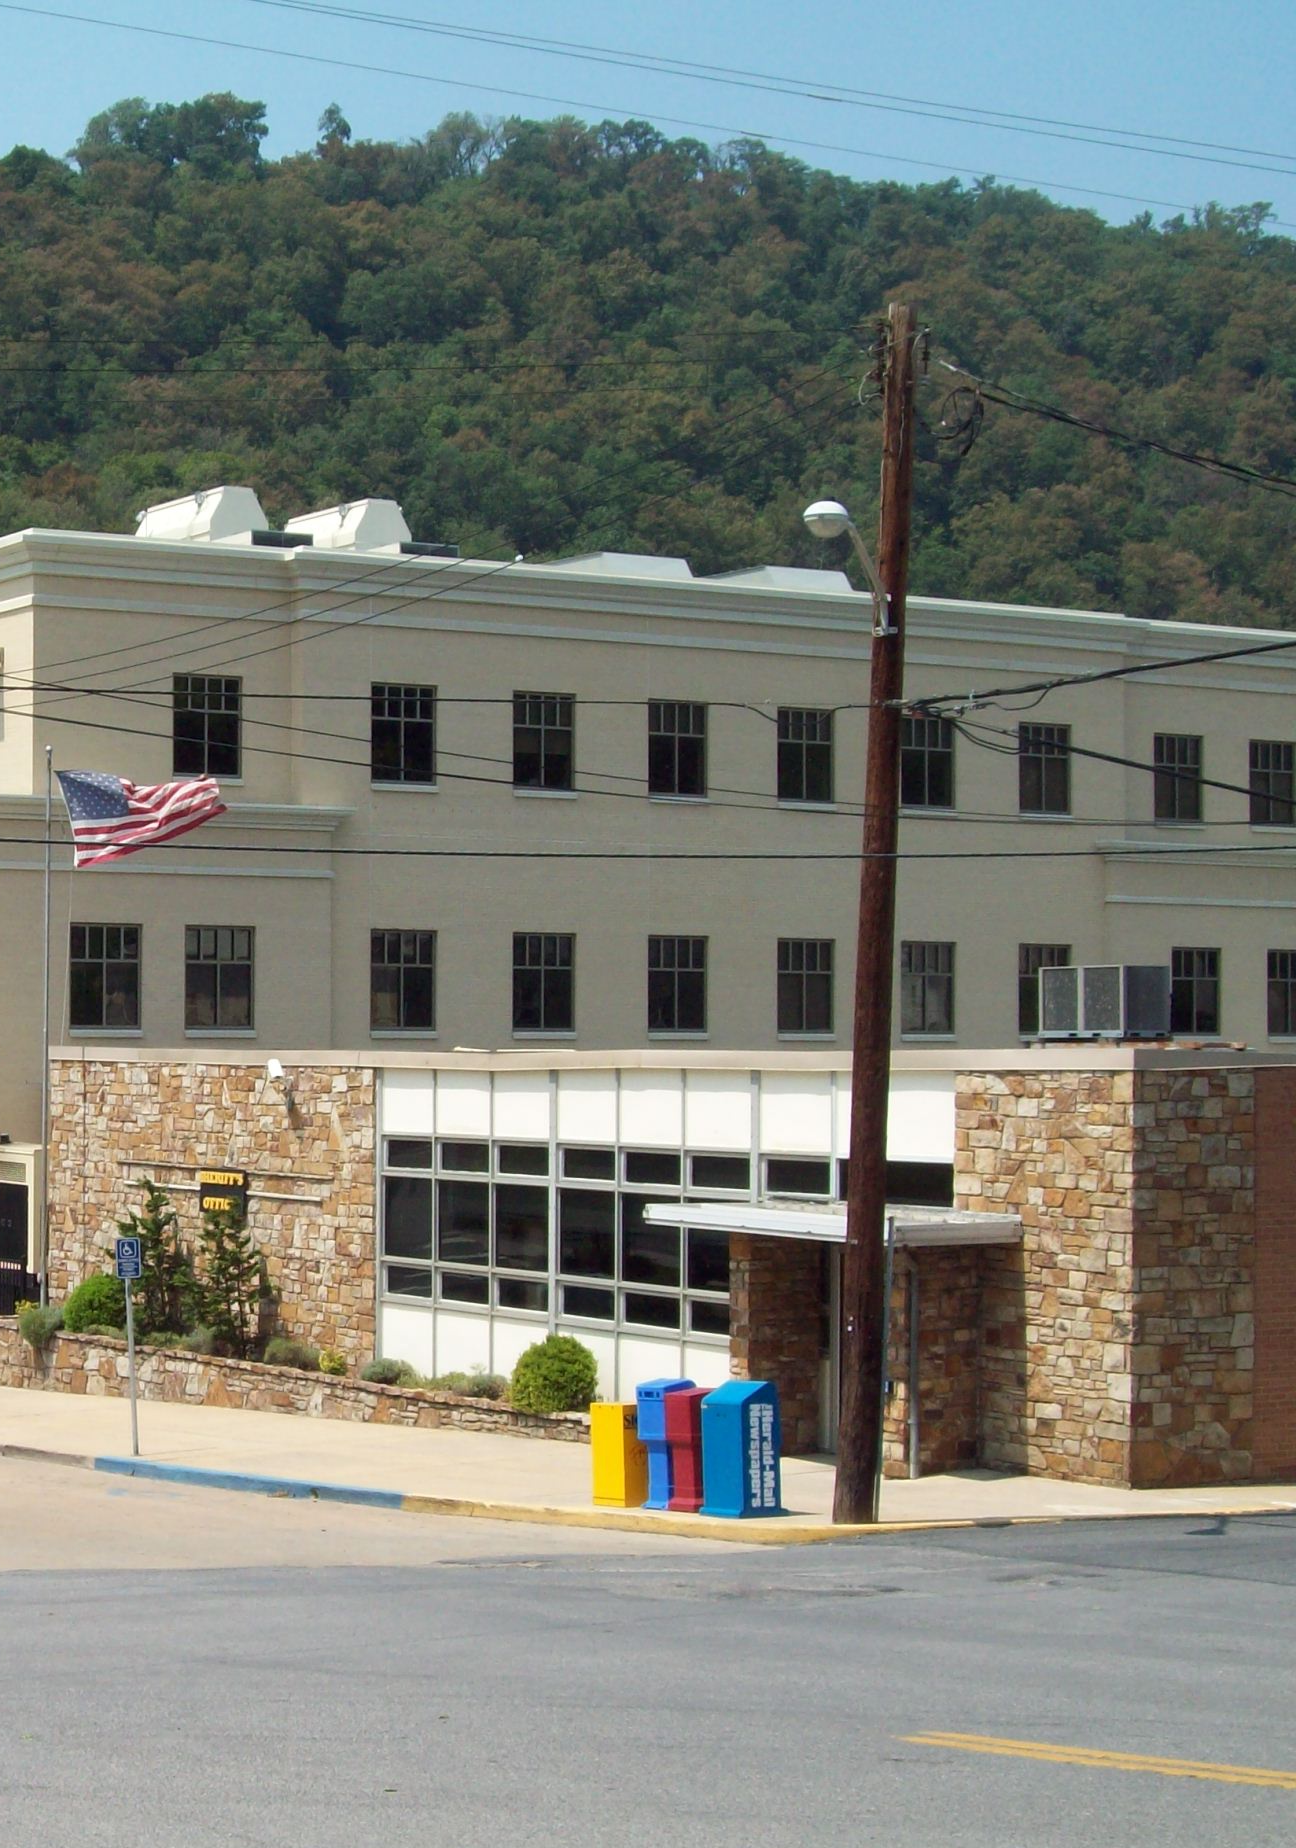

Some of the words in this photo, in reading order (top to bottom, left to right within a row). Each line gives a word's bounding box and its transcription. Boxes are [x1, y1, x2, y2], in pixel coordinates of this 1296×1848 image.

[203, 1197, 232, 1210] OFFIC
[749, 1404, 762, 1507] Newspapers
[762, 1410, 776, 1507] Herald-Mail
